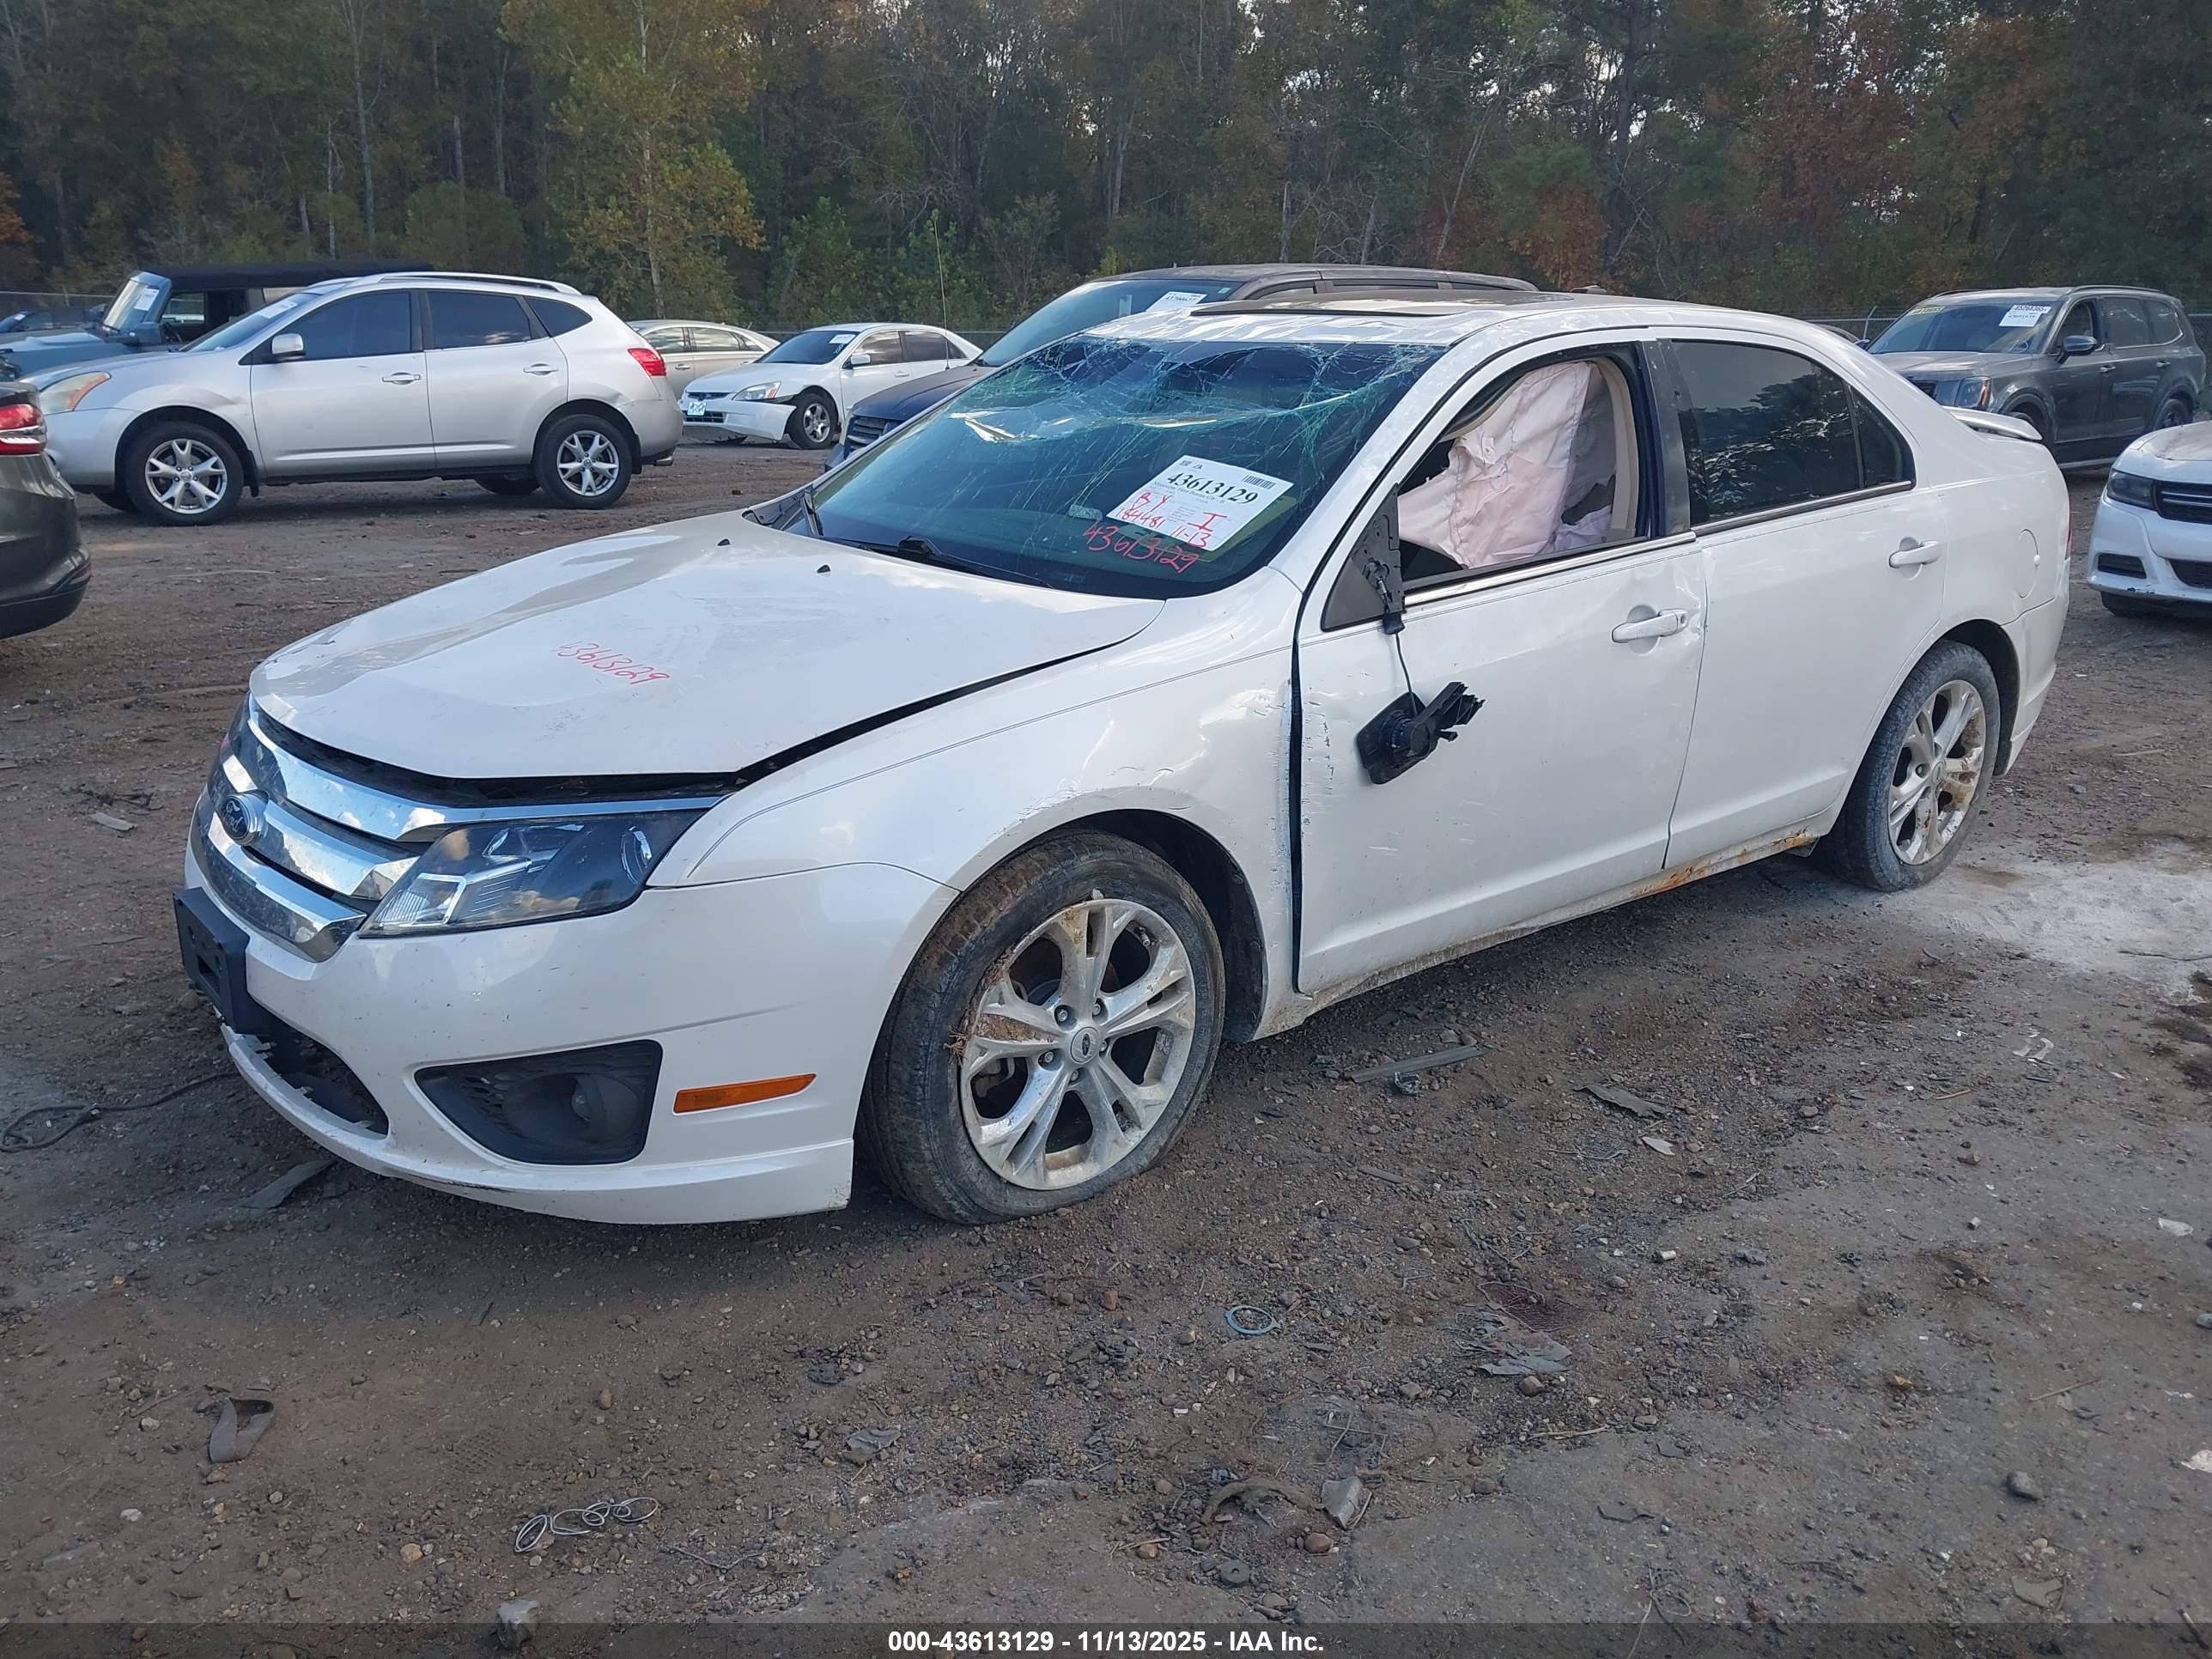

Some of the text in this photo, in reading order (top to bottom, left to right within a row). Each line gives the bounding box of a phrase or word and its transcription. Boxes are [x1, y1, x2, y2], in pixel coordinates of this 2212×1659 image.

[1167, 471, 1258, 505] 43613129
[1082, 520, 1200, 574] 43613129
[222, 799, 244, 833] Ford
